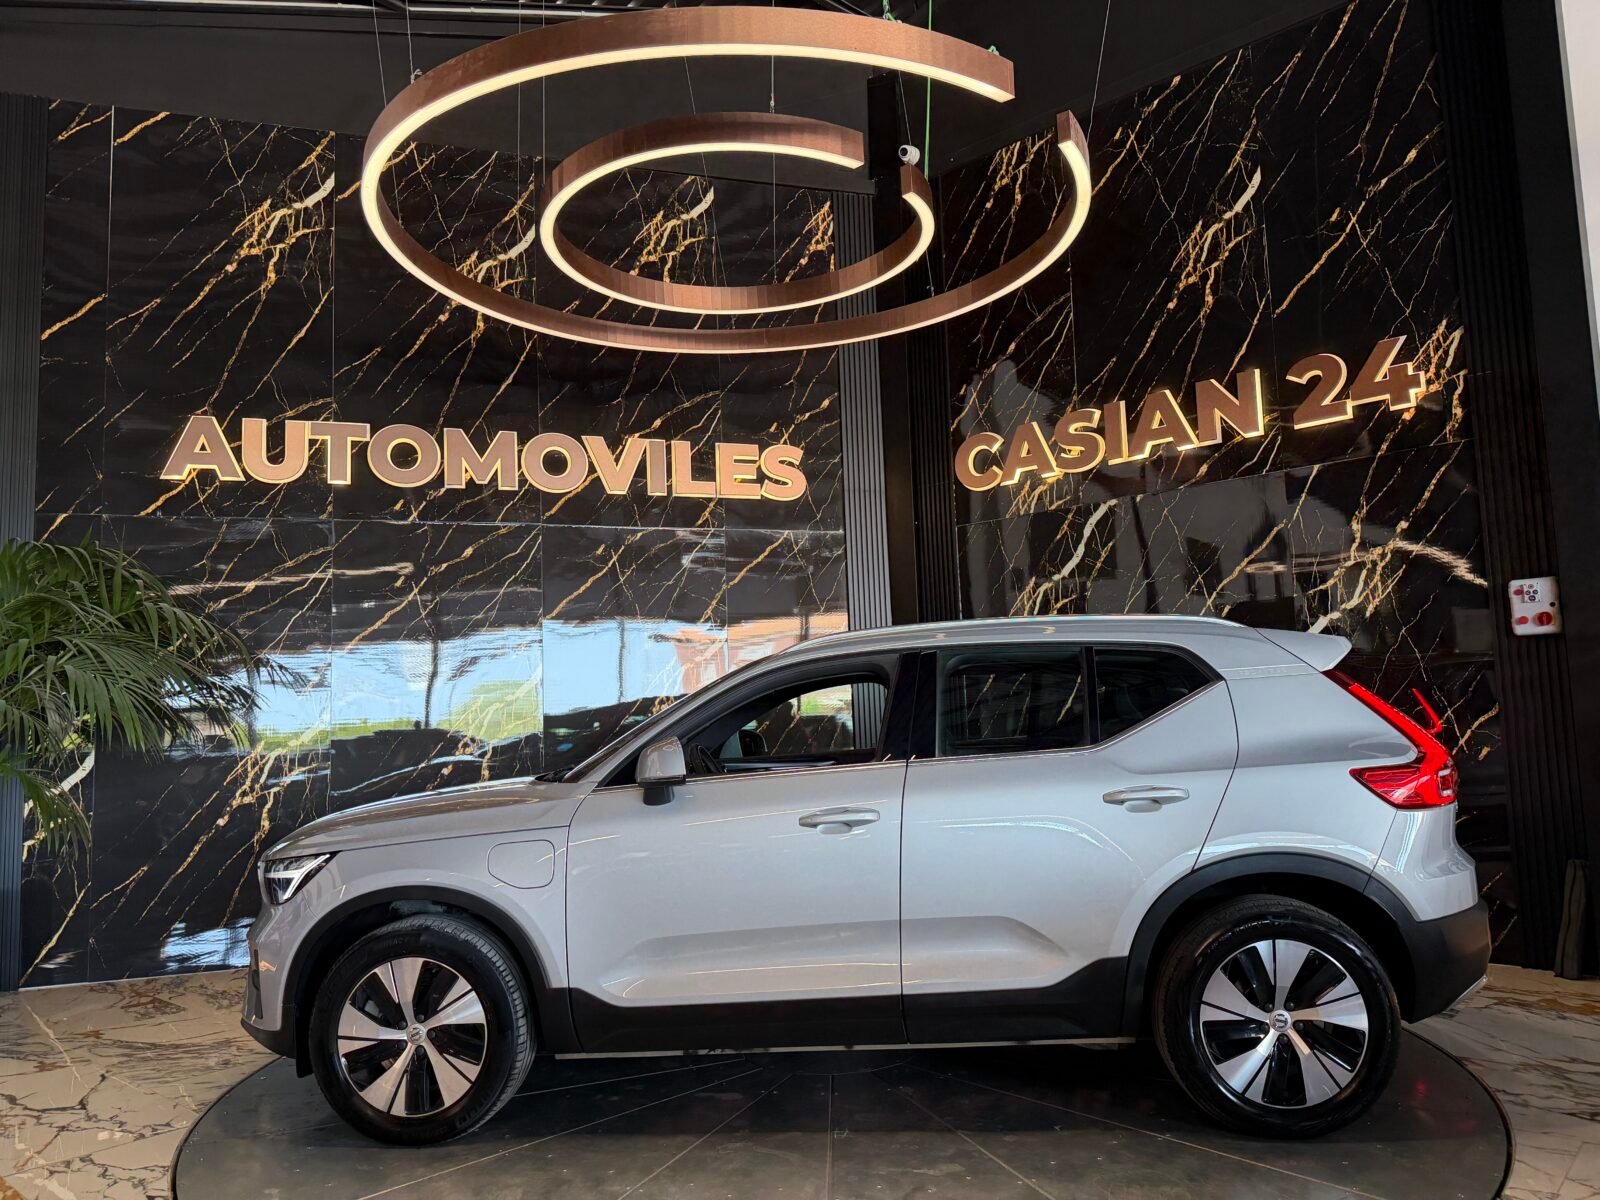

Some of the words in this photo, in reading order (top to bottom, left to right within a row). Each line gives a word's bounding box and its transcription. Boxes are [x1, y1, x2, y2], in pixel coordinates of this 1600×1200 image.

[160, 414, 807, 501] AUTOMOVILES
[954, 368, 1265, 492] CASIAN
[1286, 335, 1427, 430] 24
